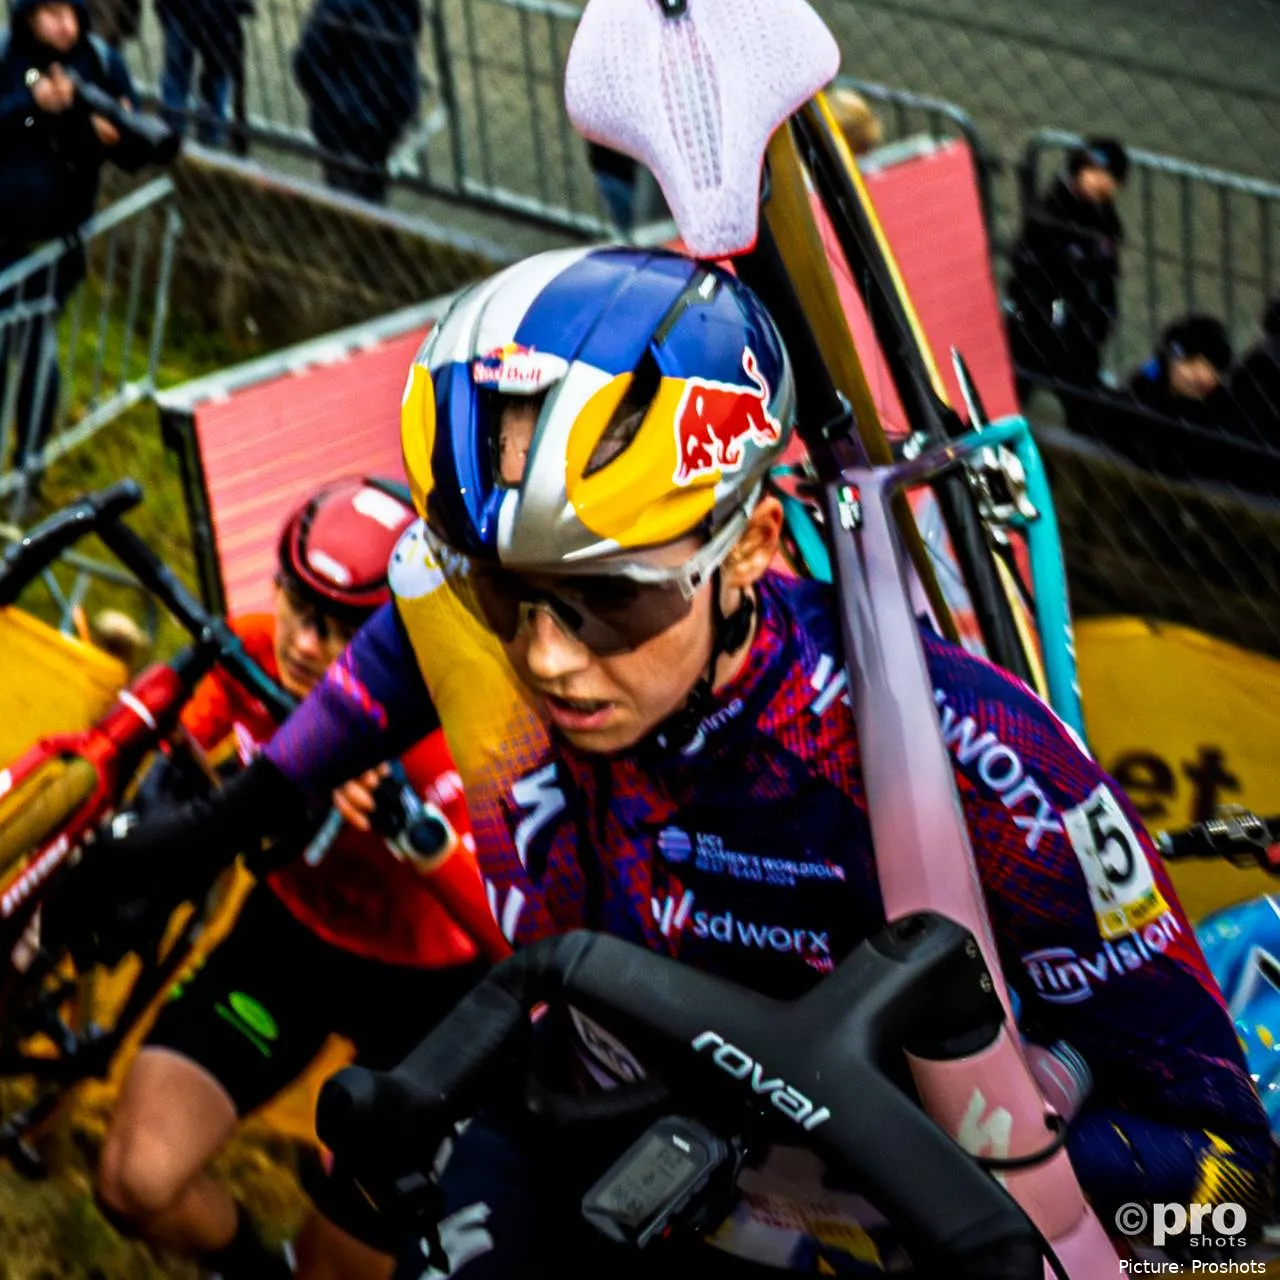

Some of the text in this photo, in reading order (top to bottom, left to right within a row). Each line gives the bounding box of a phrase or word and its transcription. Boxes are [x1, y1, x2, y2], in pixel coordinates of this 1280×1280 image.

[935, 689, 1066, 852] worx
[1085, 798, 1135, 886] 5
[691, 1030, 831, 1131] roval
